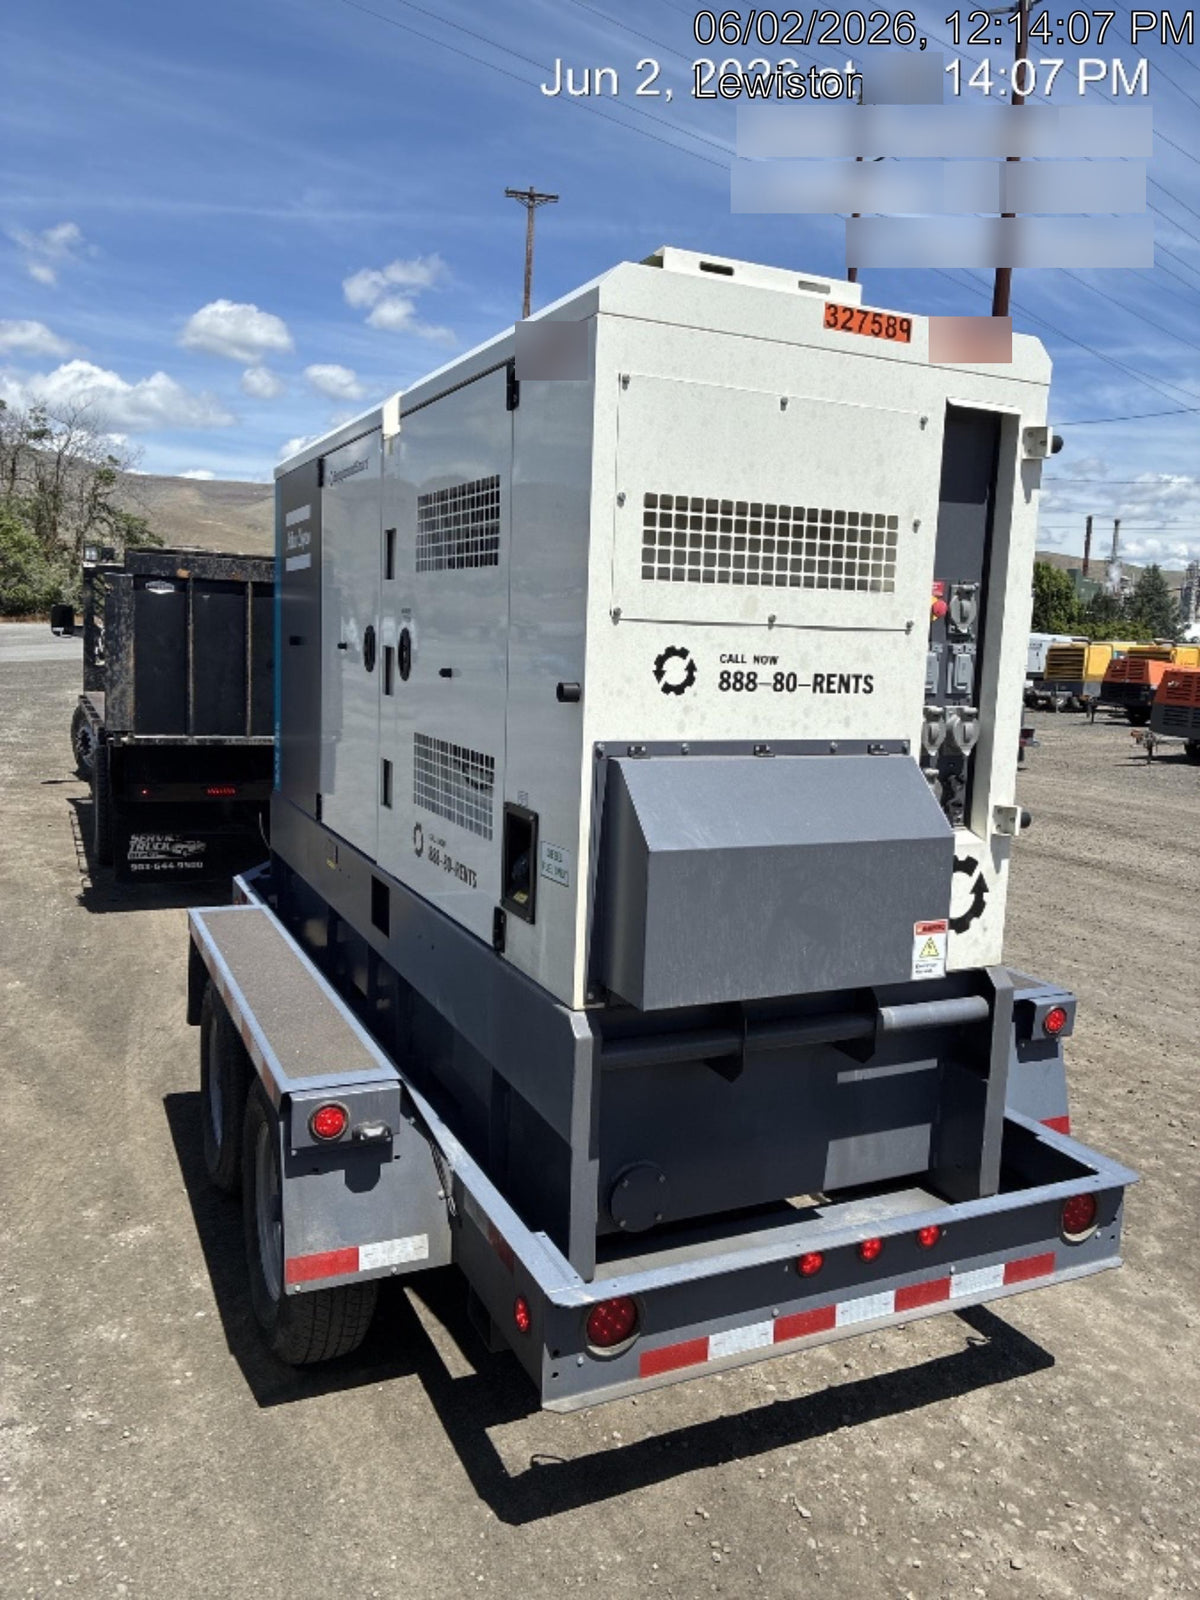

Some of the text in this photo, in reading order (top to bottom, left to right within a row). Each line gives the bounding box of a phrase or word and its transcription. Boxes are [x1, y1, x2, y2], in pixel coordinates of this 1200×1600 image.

[825, 304, 912, 343] 327589
[719, 653, 779, 666] CALL NOW
[718, 670, 874, 694] 888-80-RENTS
